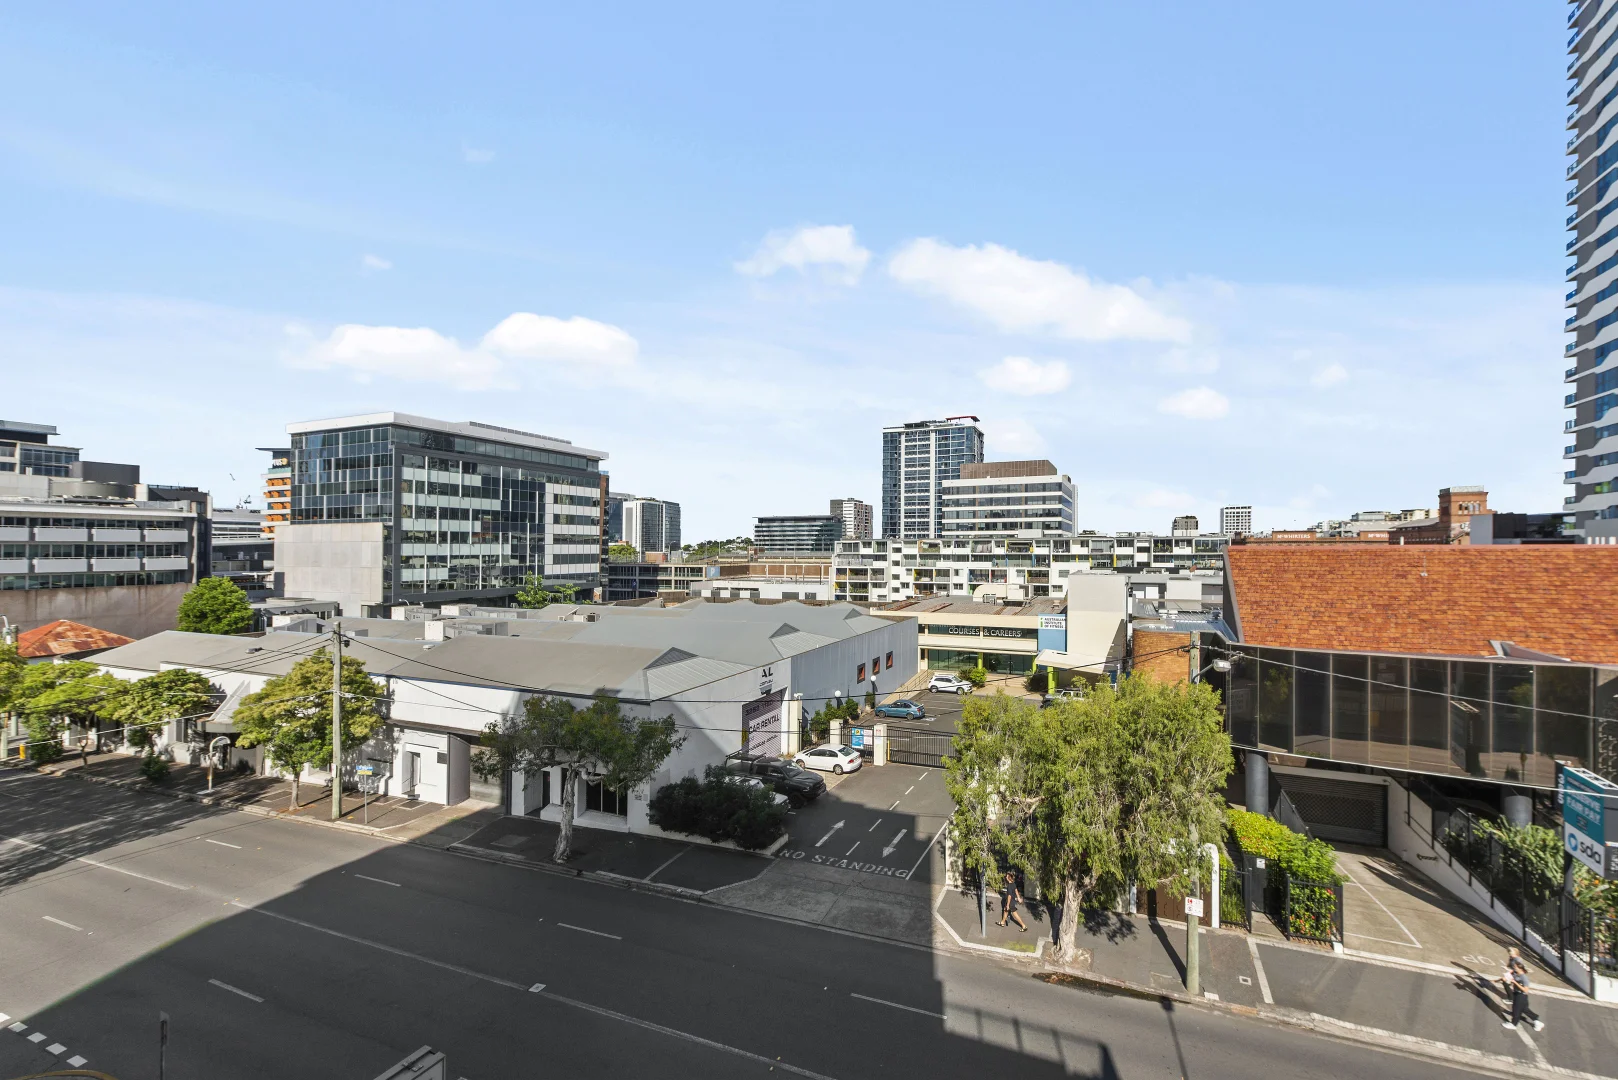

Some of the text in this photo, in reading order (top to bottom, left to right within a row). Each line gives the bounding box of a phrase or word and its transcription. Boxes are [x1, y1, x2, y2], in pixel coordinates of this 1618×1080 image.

[948, 627, 1021, 637] COURSES & CAREERS
[748, 713, 780, 734] CAR RENTAL
[779, 849, 909, 878] NO STANDING
[1580, 841, 1601, 865] sda
